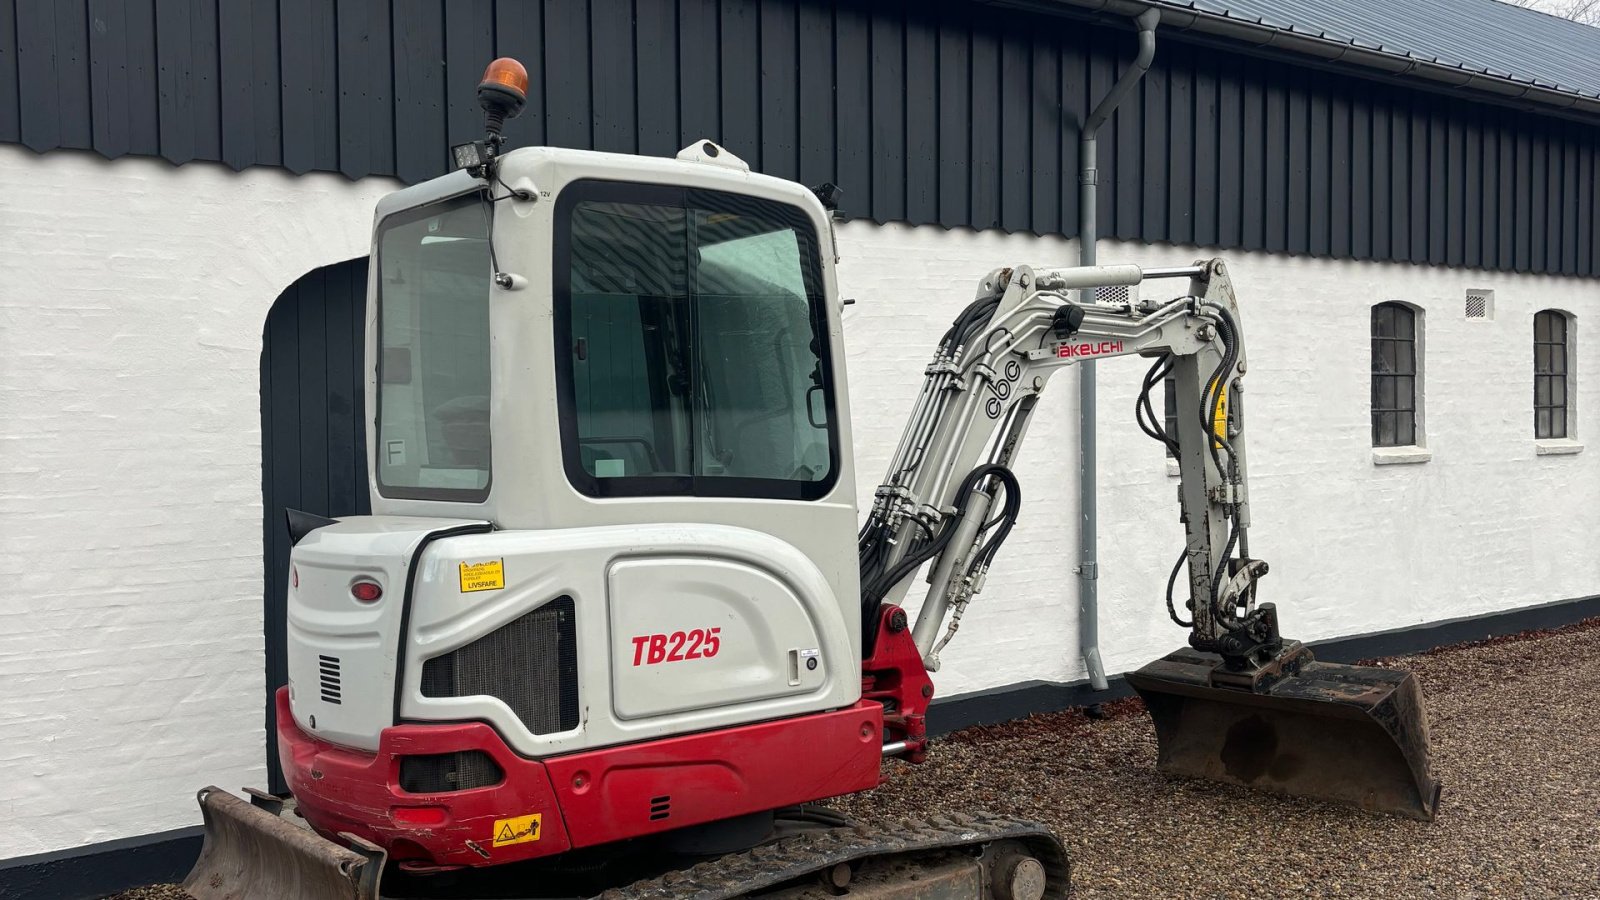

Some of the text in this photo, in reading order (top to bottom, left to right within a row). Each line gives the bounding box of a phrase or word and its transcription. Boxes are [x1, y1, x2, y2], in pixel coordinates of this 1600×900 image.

[387, 440, 403, 465] F
[467, 580, 498, 589] LIVSFARE
[632, 627, 721, 667] TB225
